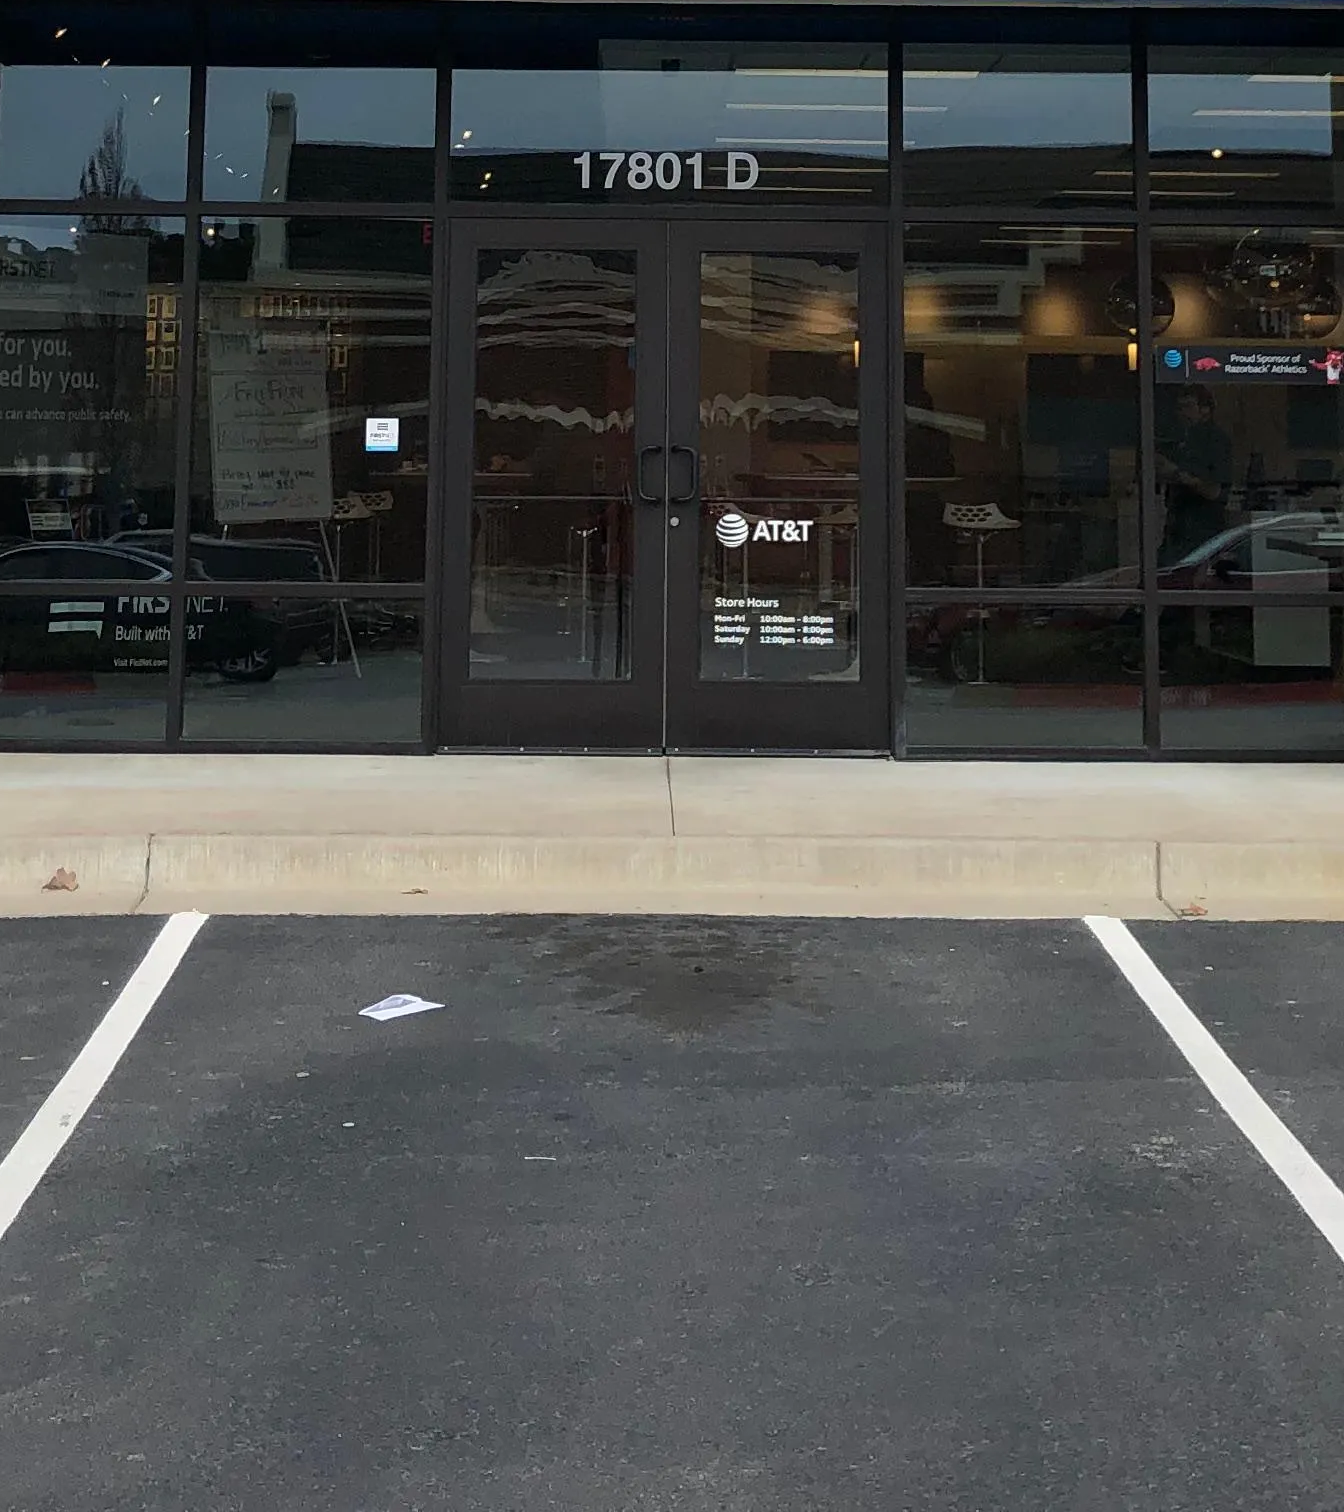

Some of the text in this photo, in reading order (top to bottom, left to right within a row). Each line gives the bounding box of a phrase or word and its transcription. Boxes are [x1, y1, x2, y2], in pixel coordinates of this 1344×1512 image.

[572, 151, 759, 190] 17801 D
[31, 336, 73, 361] you.
[1229, 353, 1302, 365] Proud Sponsor of
[1271, 364, 1308, 374] Athletics
[28, 364, 54, 394] by
[58, 370, 101, 395] you.
[5, 410, 23, 421] can
[25, 407, 66, 422] advance
[67, 407, 97, 423] public
[752, 519, 814, 542] AT&T
[714, 597, 780, 608] Store Hours
[714, 614, 746, 623] Mon-Fri
[759, 615, 796, 624] 10:00am
[114, 624, 143, 641] Built
[144, 624, 171, 641] with
[714, 625, 751, 635] Saturday
[759, 626, 796, 634] 10:00am
[714, 635, 745, 645] Sunday
[759, 636, 796, 645] 12:00pm
